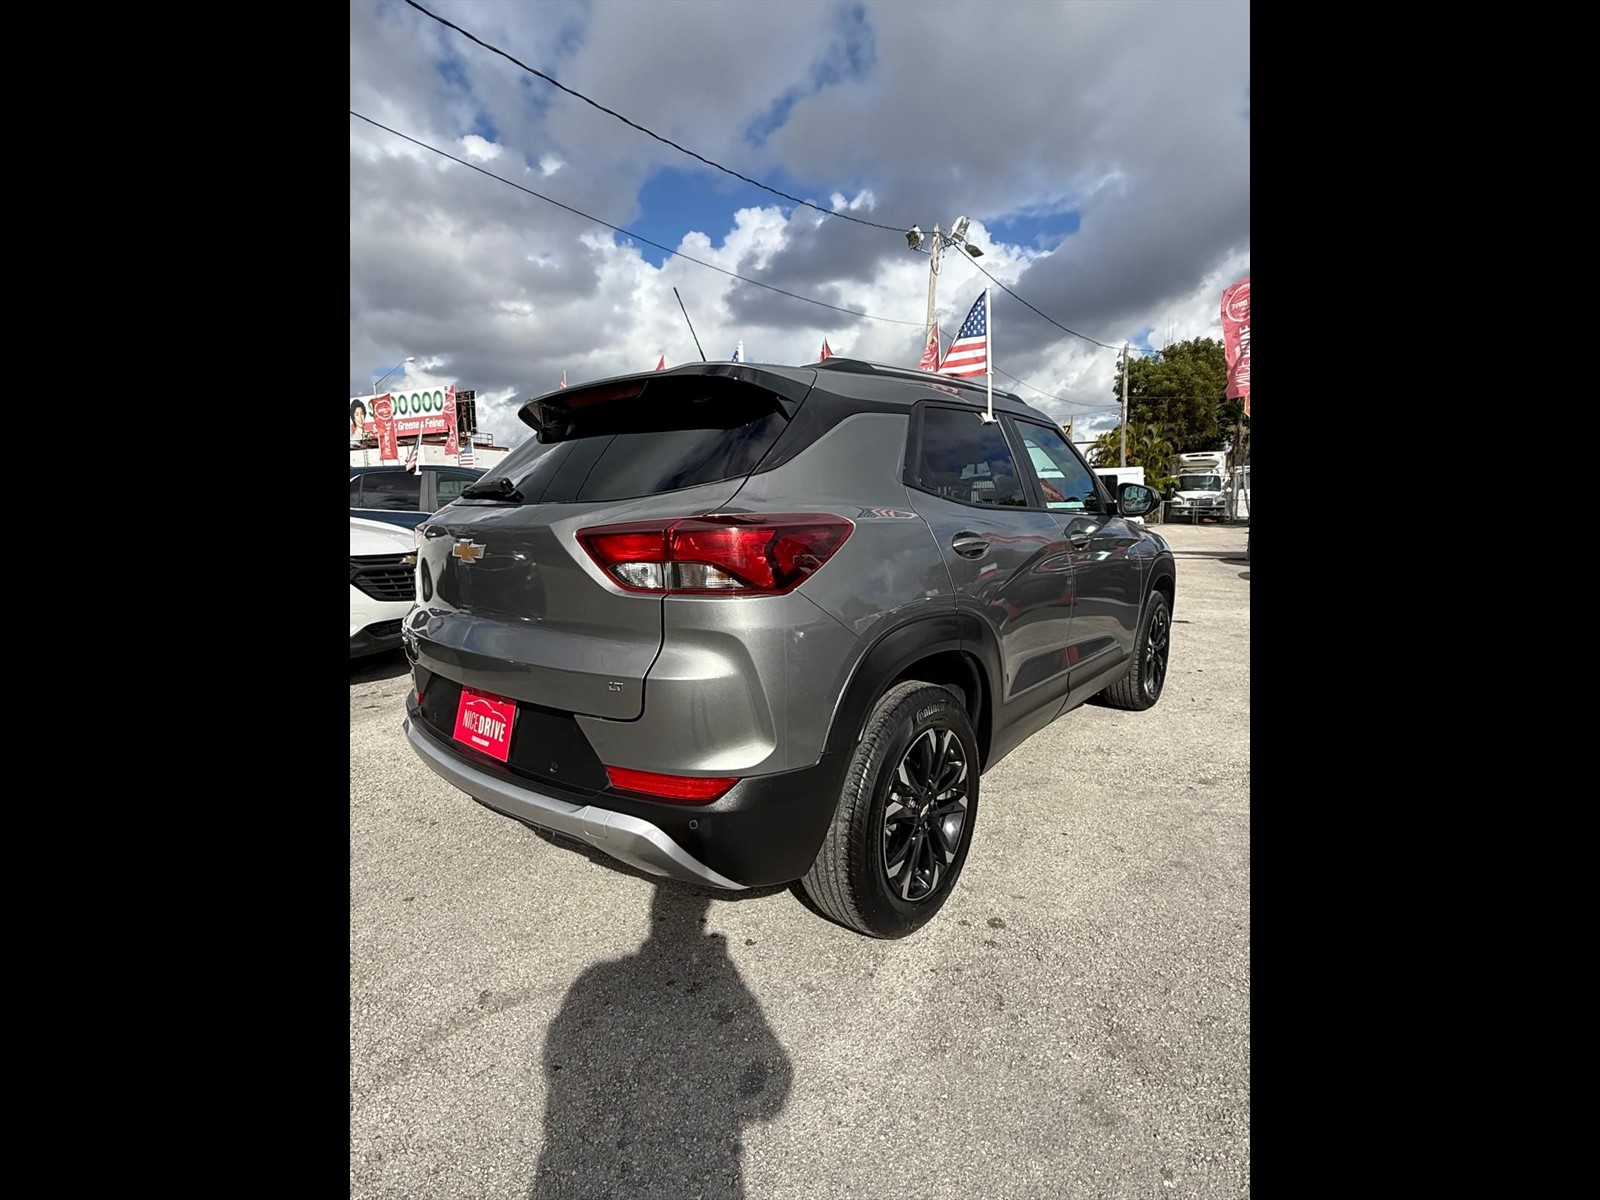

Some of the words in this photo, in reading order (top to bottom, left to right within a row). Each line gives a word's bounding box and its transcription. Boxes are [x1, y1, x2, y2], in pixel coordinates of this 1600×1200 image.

[368, 391, 444, 417] 00,000
[397, 420, 420, 431] Greene
[424, 417, 446, 428] Feiner
[609, 681, 624, 692] LT
